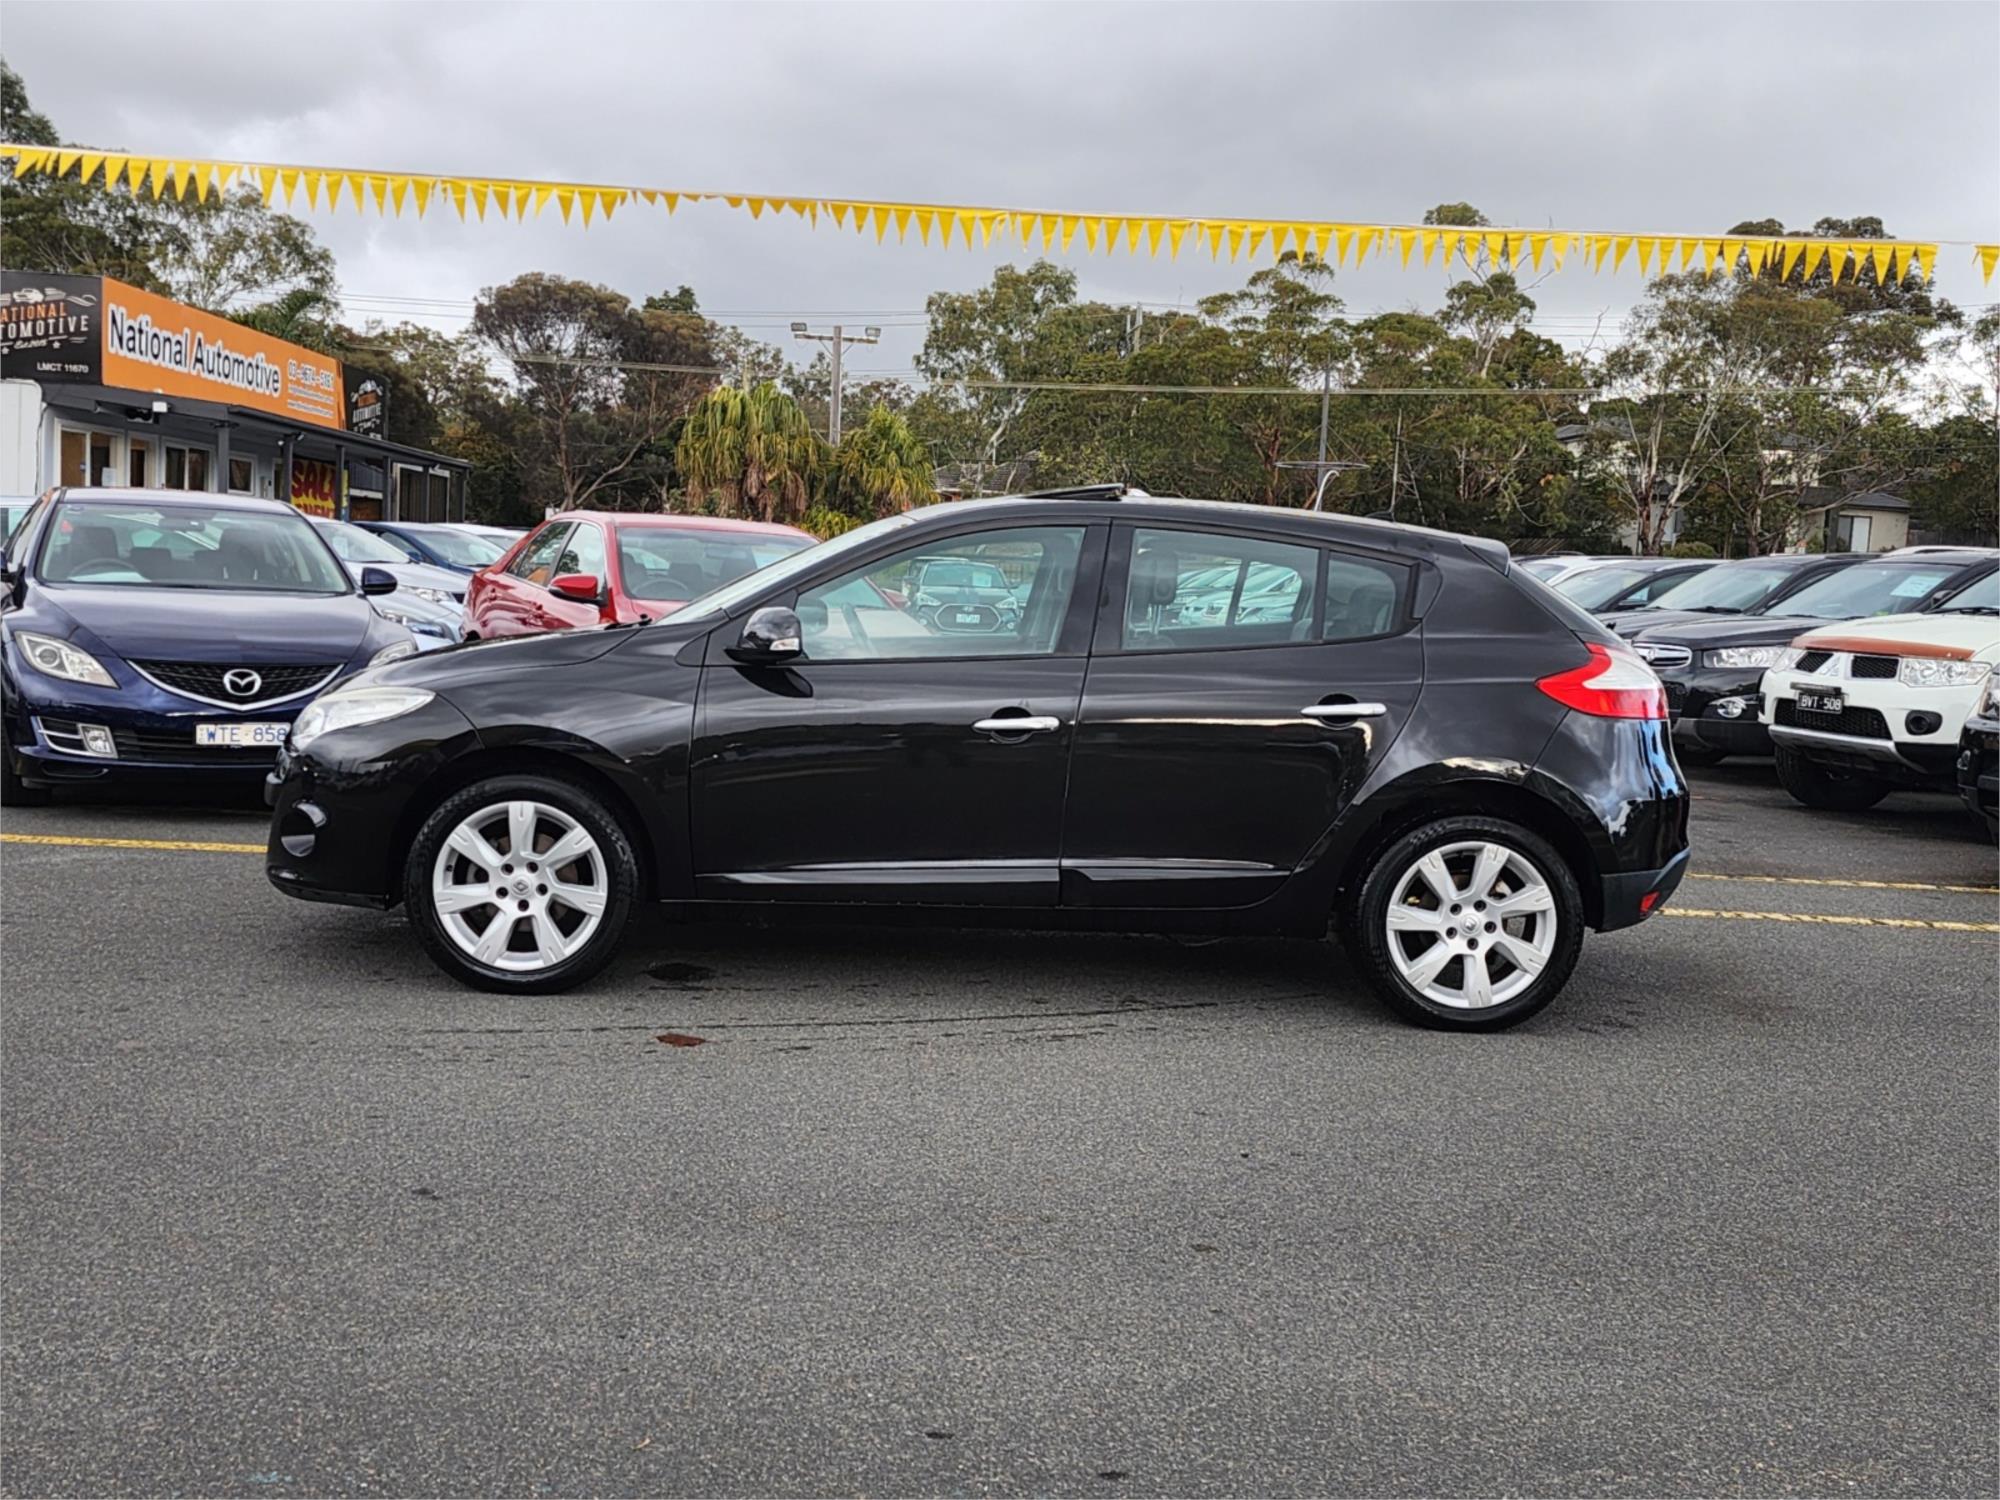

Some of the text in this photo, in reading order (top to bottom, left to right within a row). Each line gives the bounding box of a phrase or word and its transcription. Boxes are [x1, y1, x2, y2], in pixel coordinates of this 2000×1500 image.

[0, 301, 67, 323] ATIONAL
[0, 315, 89, 340] TOMOTIVE
[109, 305, 281, 397] National Automotive
[36, 362, 62, 372] LMCT
[207, 726, 241, 743] WTE
[253, 726, 287, 743] 858
